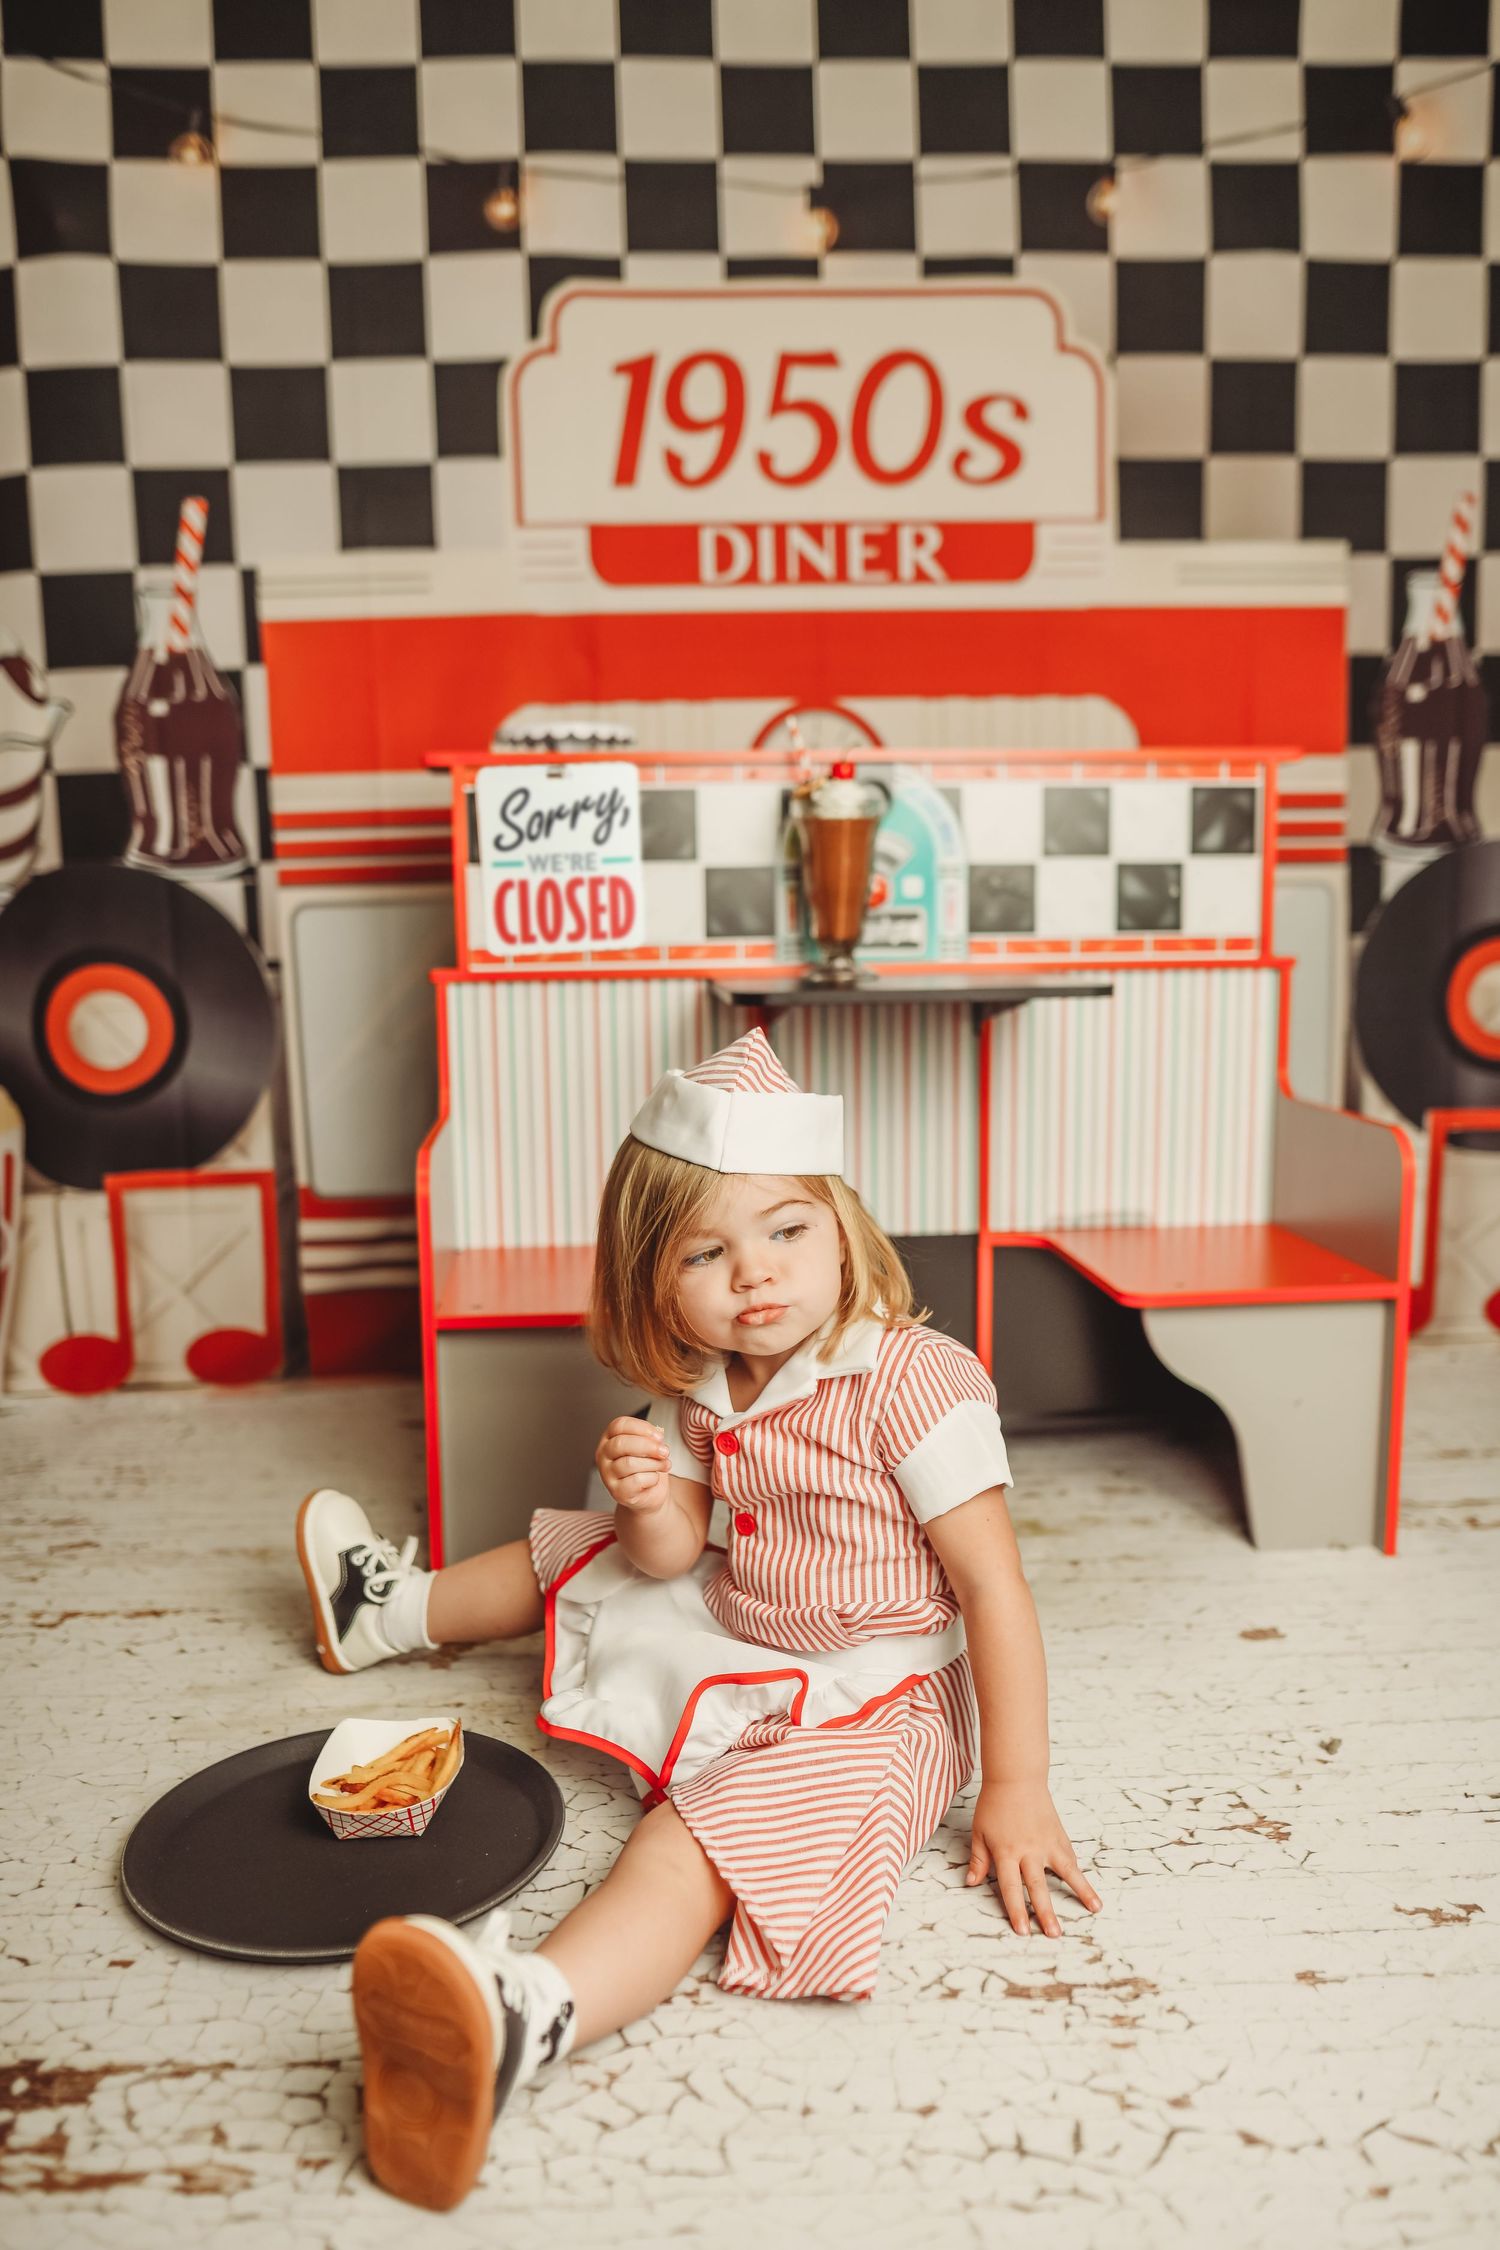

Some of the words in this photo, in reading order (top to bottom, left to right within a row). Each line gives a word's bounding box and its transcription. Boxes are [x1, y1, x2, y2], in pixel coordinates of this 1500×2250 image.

[612, 350, 1030, 489] 1950s
[698, 525, 949, 582] DINER
[493, 787, 630, 852] Sorry,
[528, 853, 597, 873] WE'RE
[493, 875, 636, 945] CLOSED
